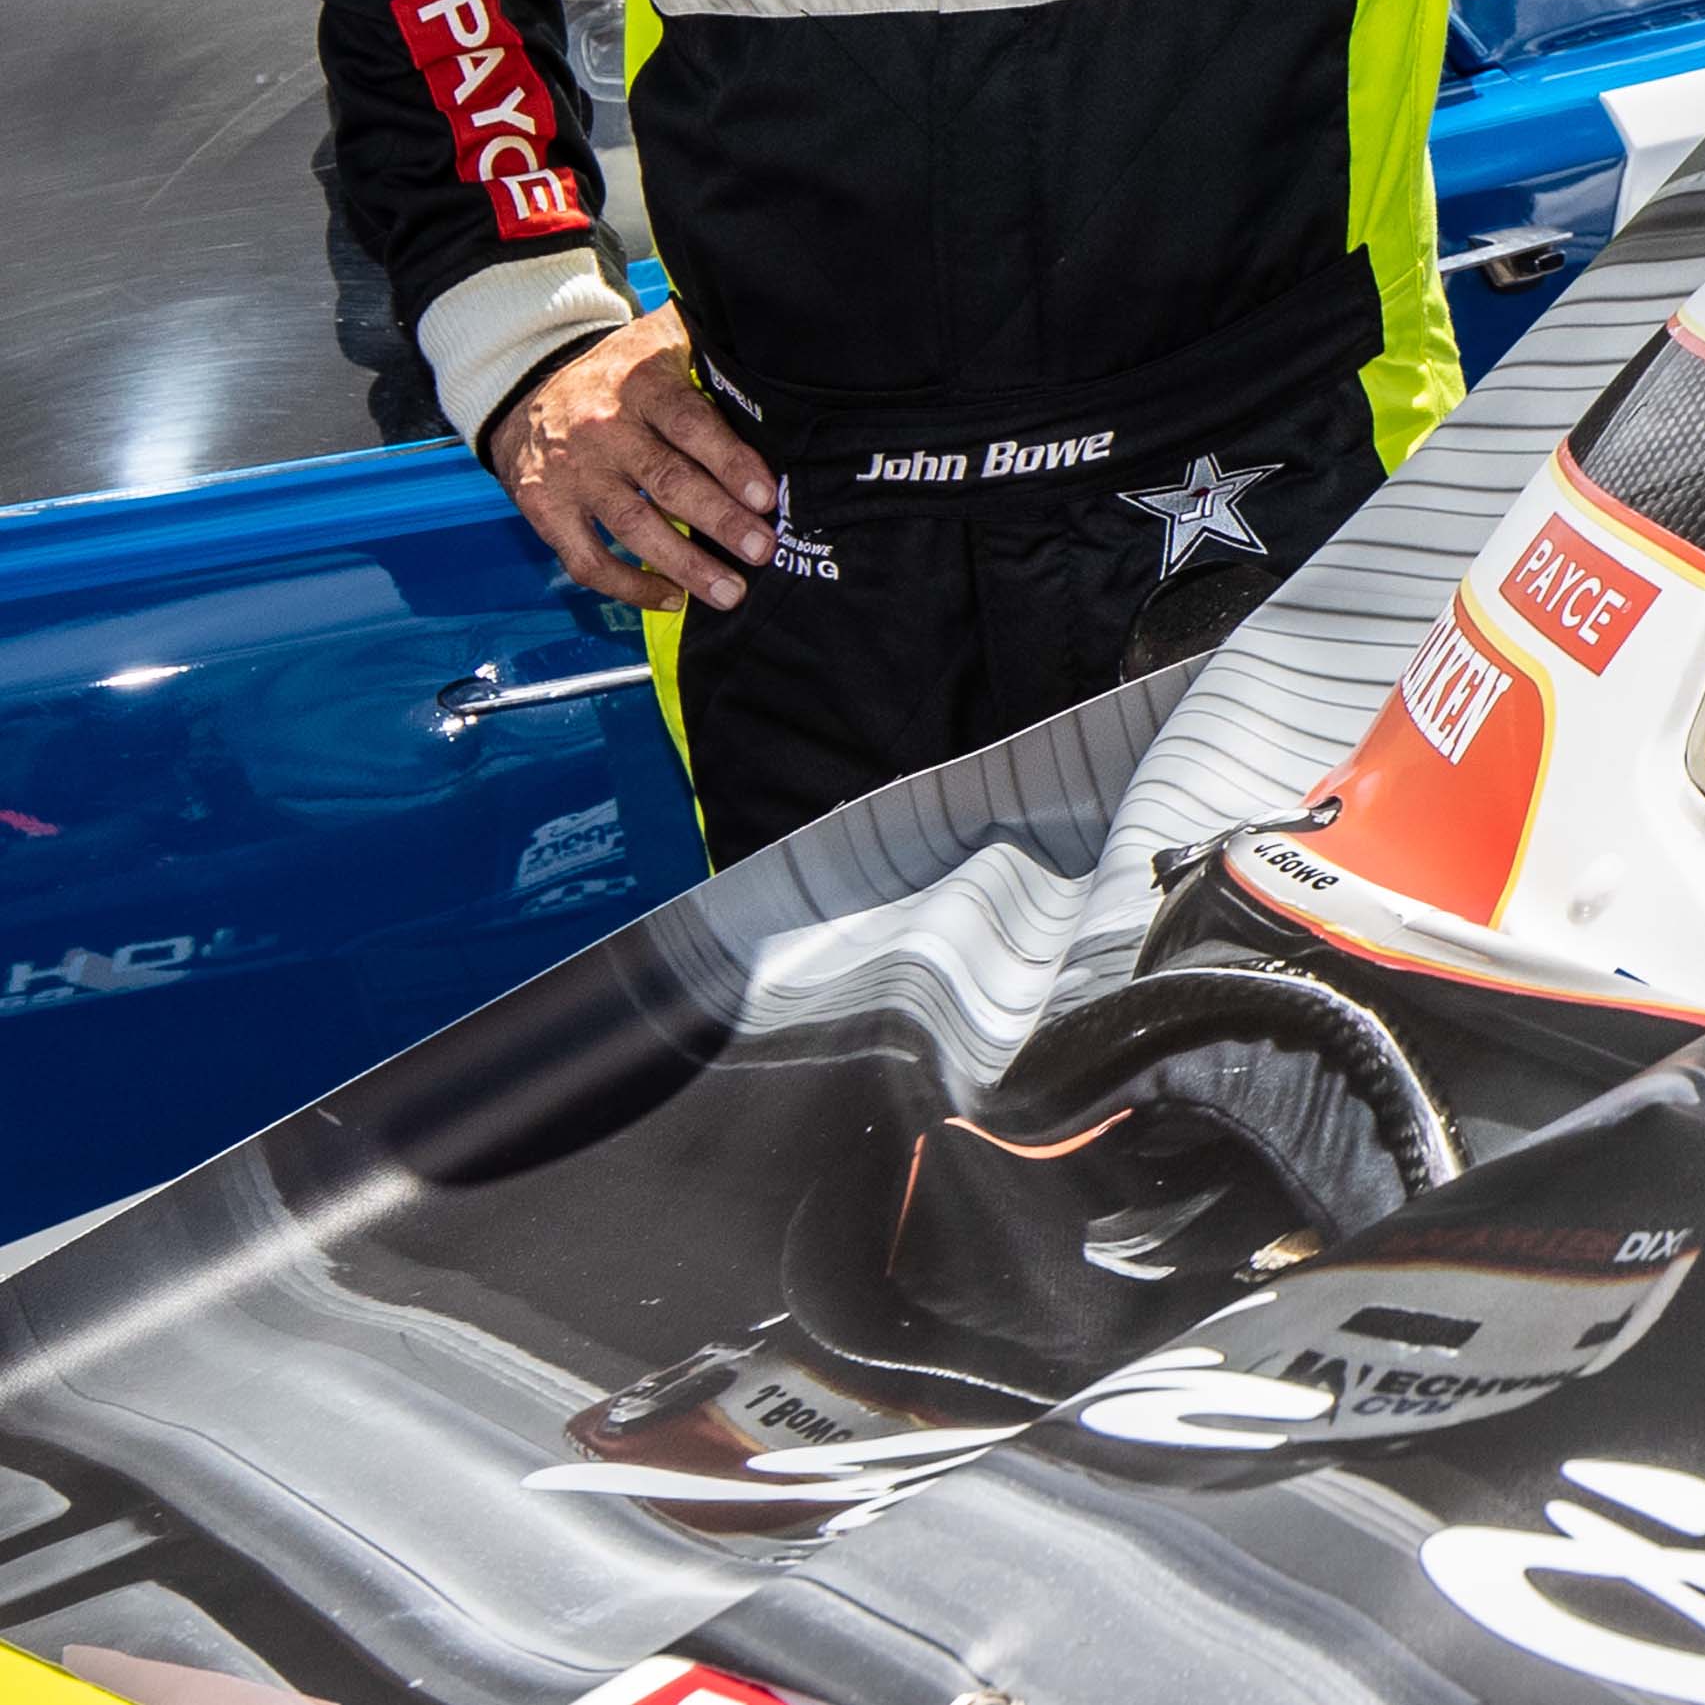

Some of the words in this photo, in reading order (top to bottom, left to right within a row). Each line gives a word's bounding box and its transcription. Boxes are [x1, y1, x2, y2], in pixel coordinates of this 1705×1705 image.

[856, 451, 968, 482] John
[981, 430, 1115, 479] Bowe
[773, 547, 841, 582] CING
[1515, 537, 1627, 646] PAYCE
